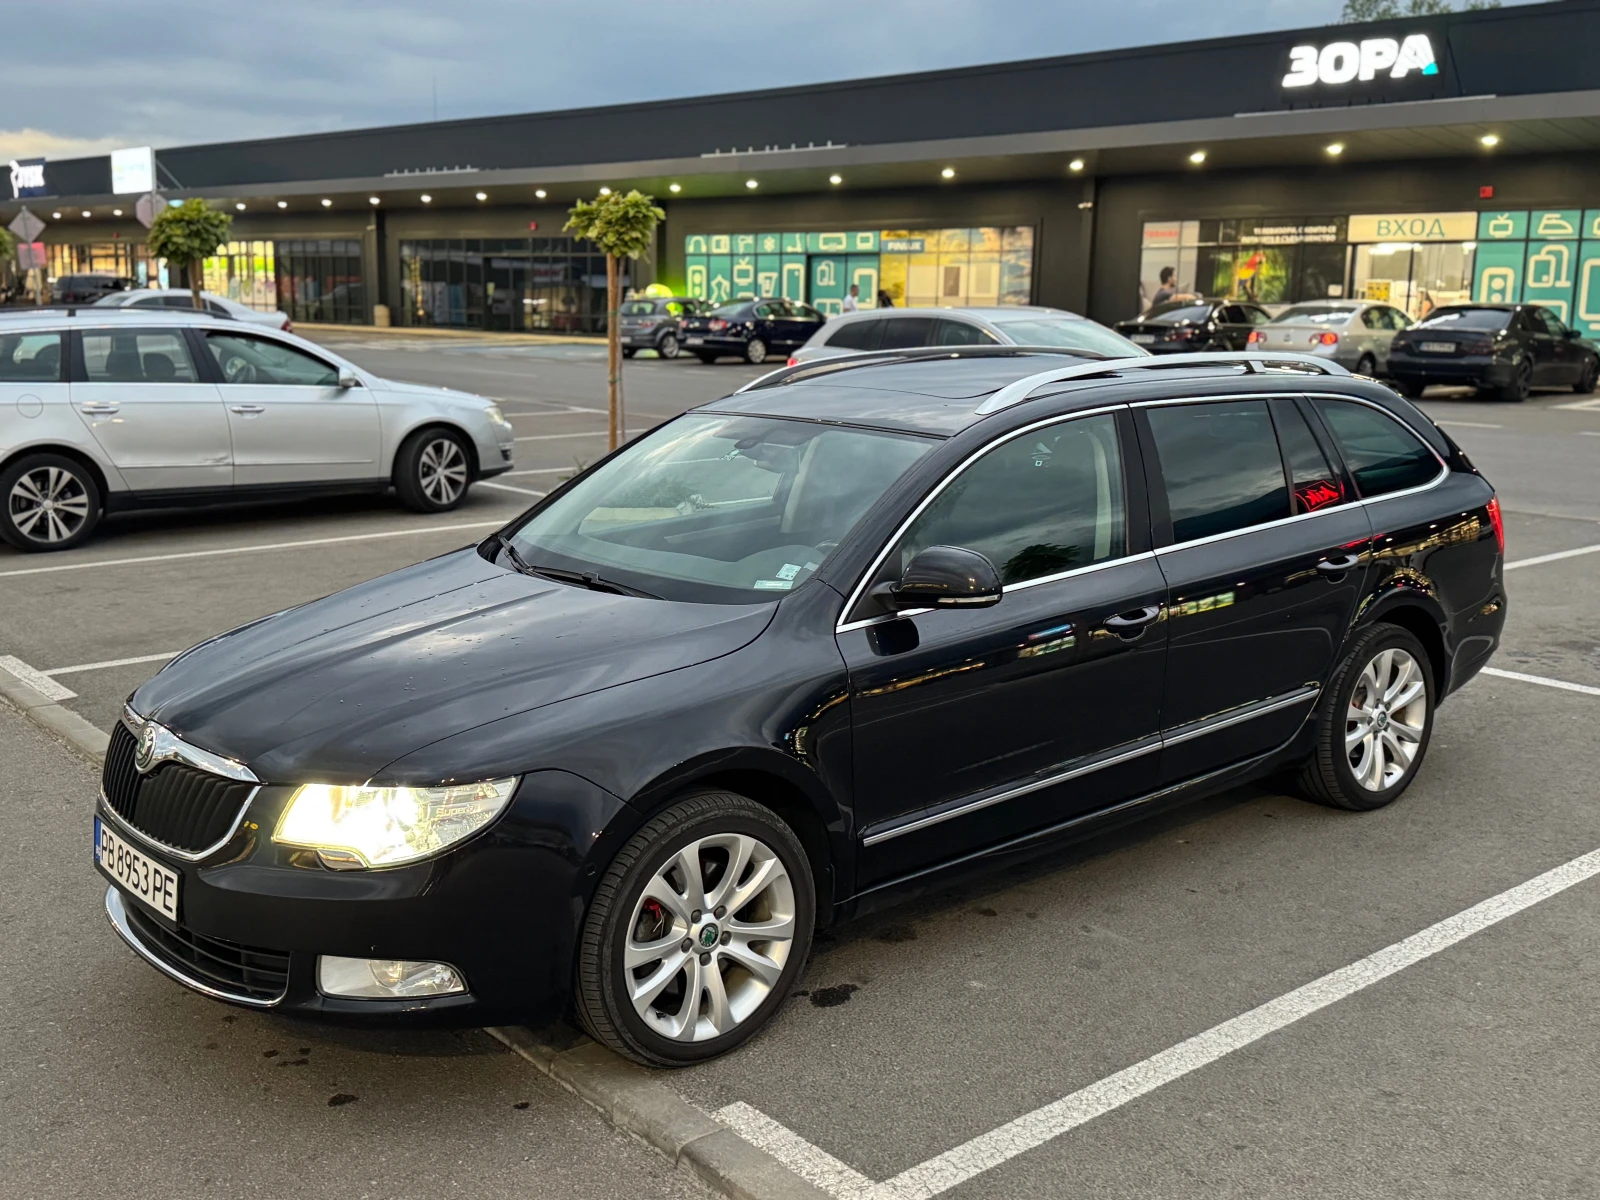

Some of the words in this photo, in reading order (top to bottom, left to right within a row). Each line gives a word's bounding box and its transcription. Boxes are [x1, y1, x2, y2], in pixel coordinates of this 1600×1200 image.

[1281, 33, 1439, 88] ЗОРА
[1376, 218, 1446, 238] ВХОД
[102, 829, 114, 870] PB
[117, 844, 149, 896] 8953
[153, 868, 174, 914] PE
